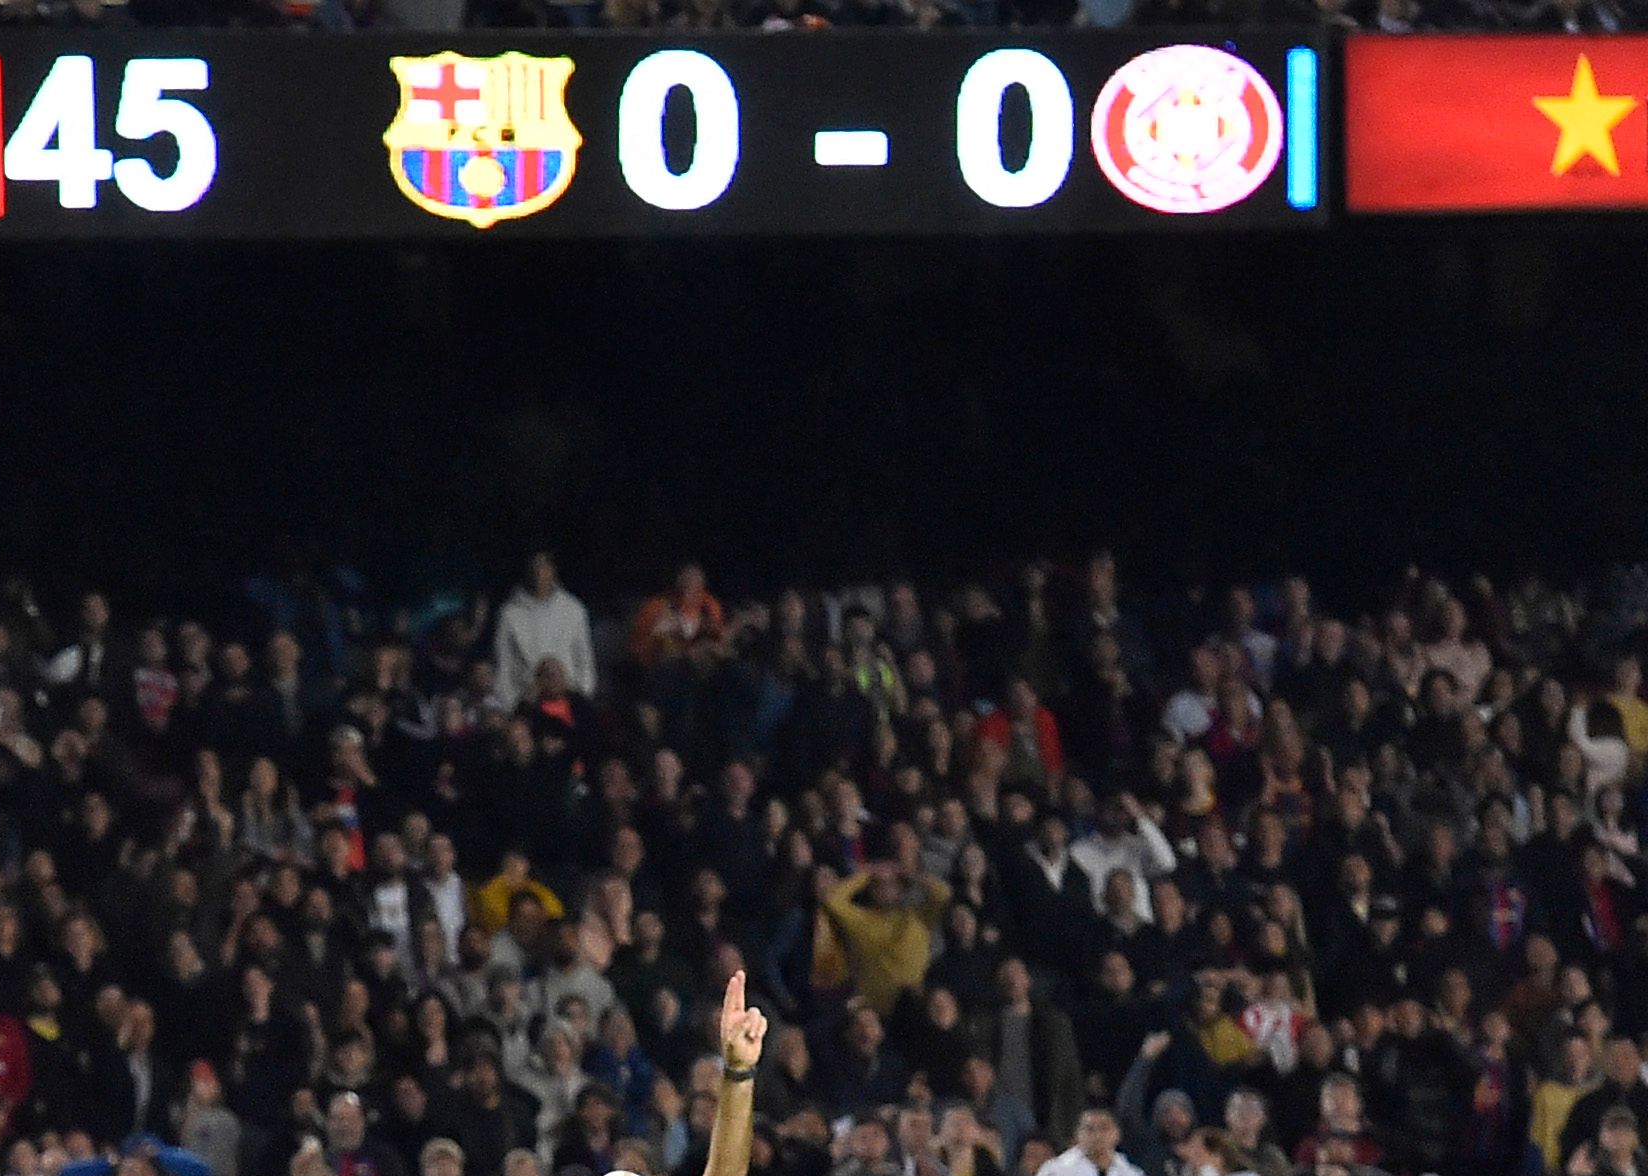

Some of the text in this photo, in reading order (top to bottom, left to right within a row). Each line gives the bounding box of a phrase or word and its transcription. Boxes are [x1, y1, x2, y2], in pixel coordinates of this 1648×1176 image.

[3, 54, 218, 213] 45
[617, 49, 740, 211] 0
[956, 47, 1074, 208] 0
